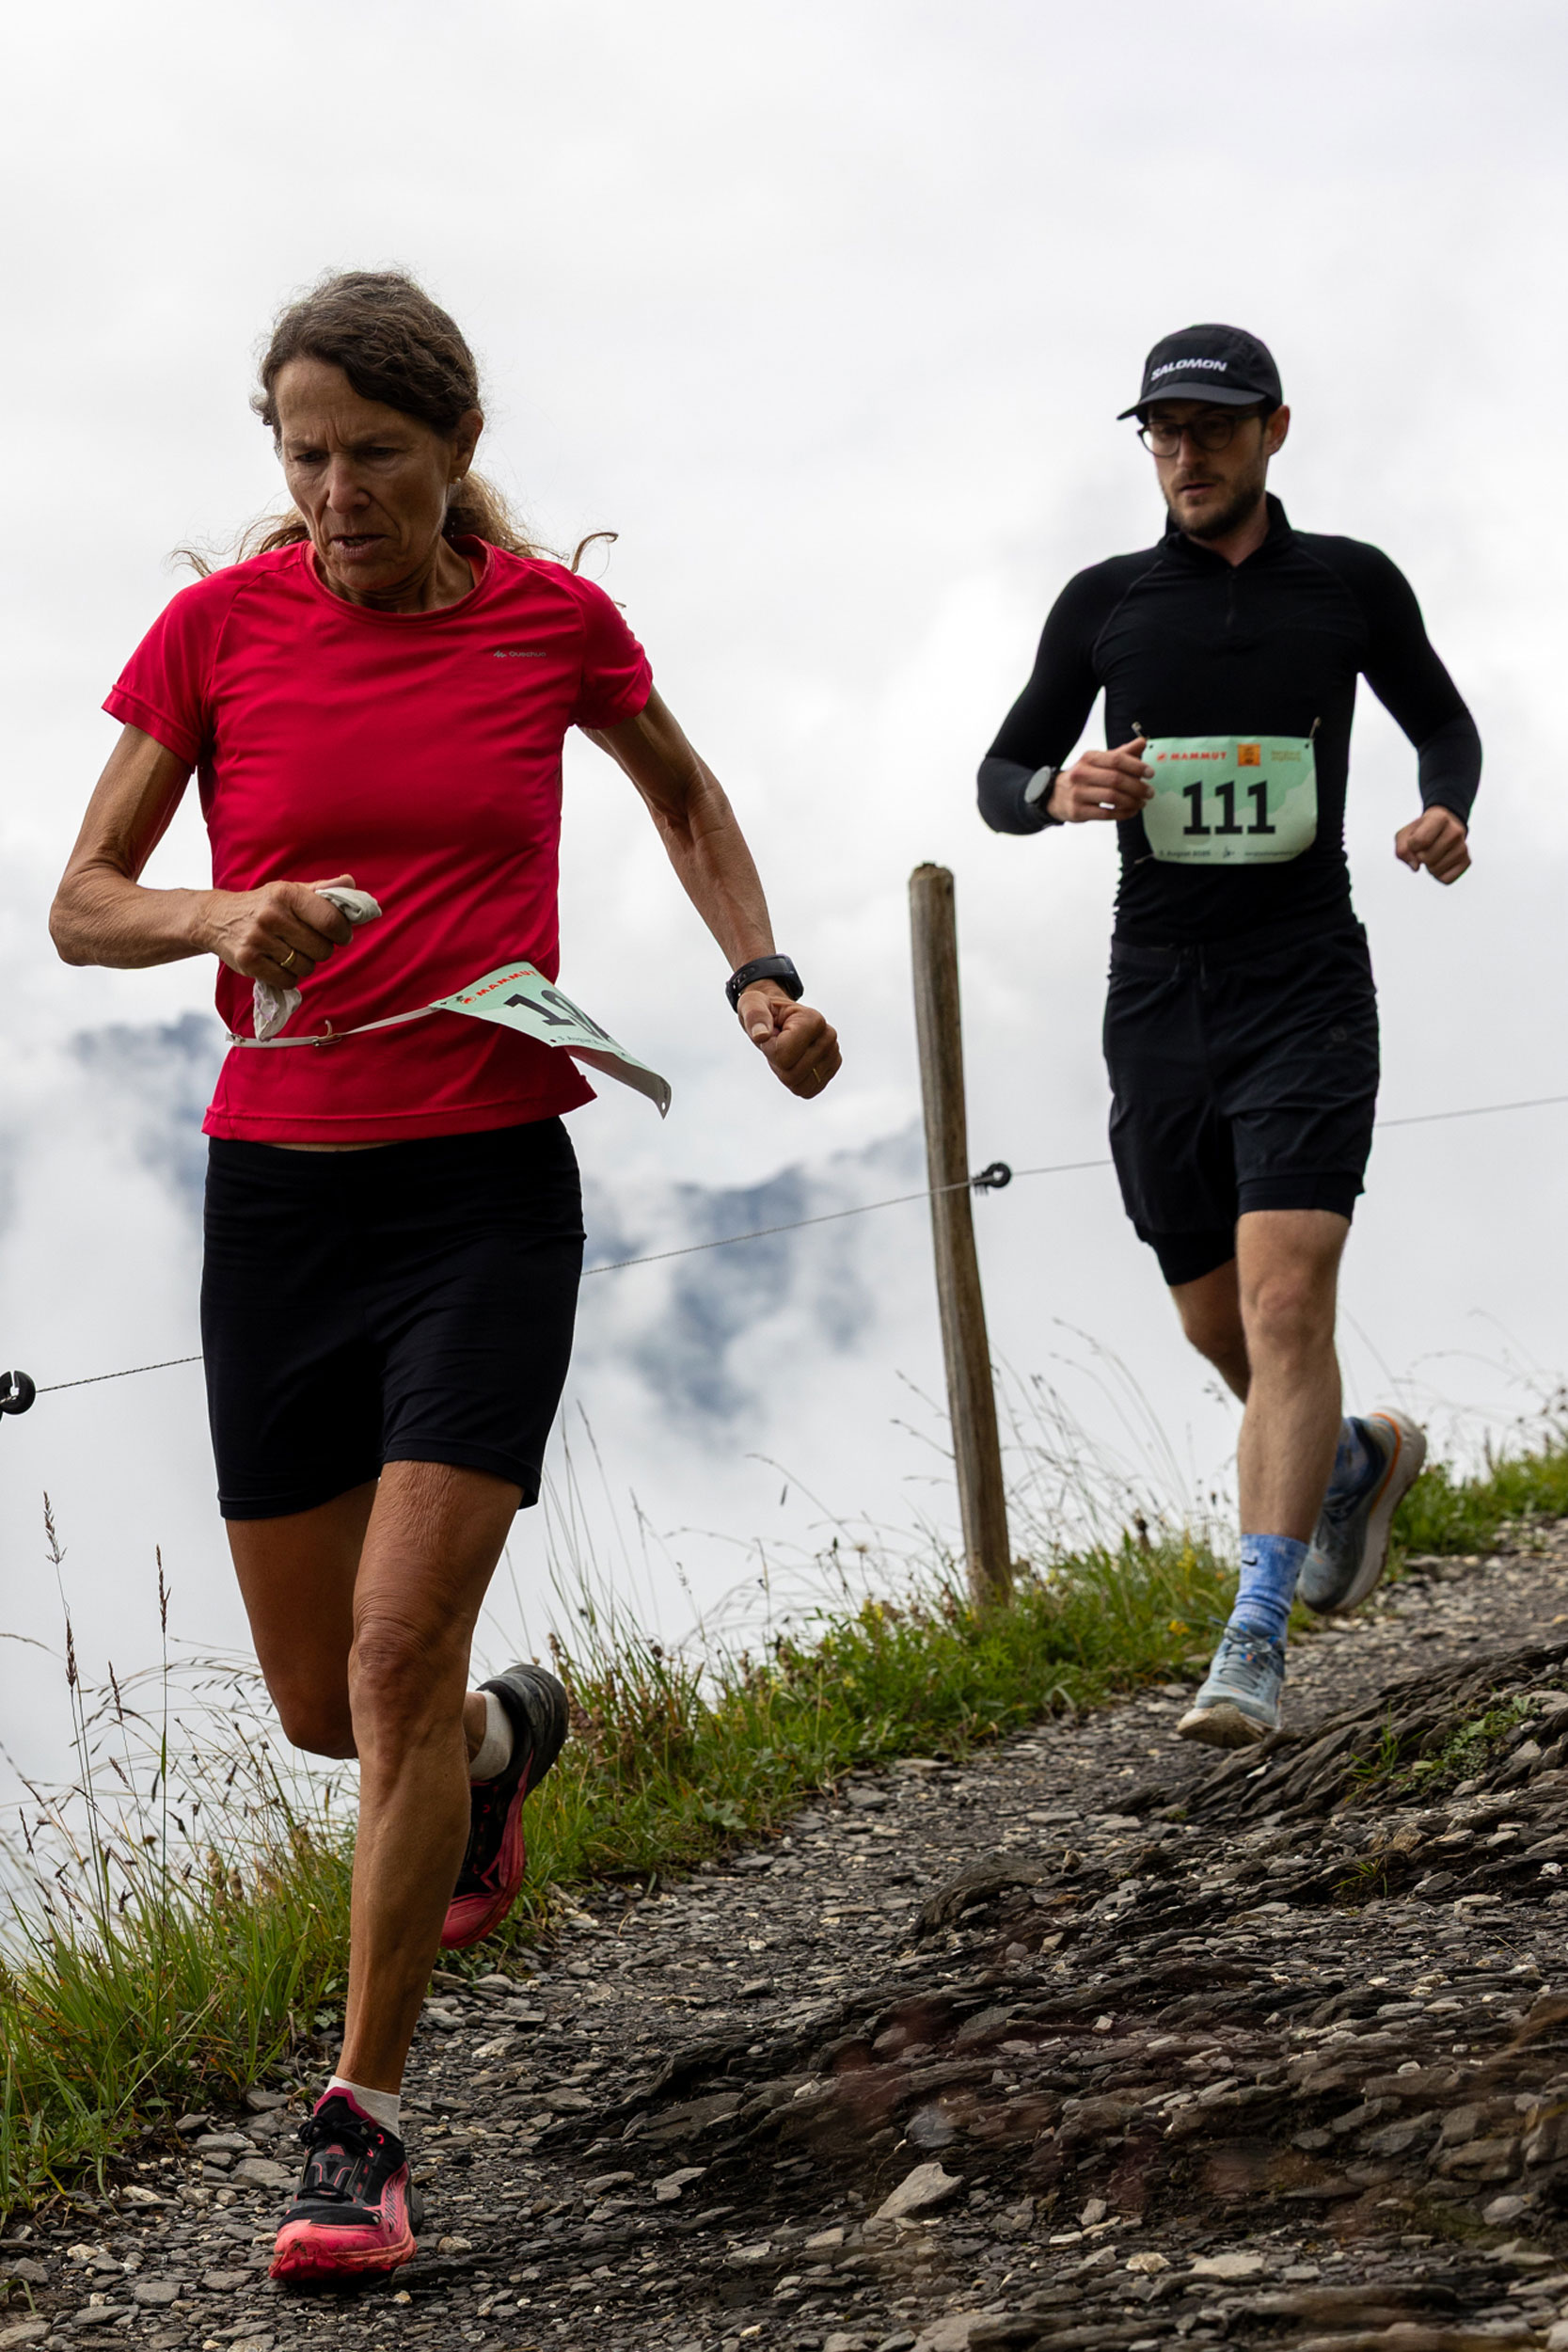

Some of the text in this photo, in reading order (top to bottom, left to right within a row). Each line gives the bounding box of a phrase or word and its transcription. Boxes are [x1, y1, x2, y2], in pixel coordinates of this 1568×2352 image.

[1150, 358, 1227, 381] SALOMON
[1170, 751, 1227, 761] MAMMUT
[1182, 780, 1275, 835] 111
